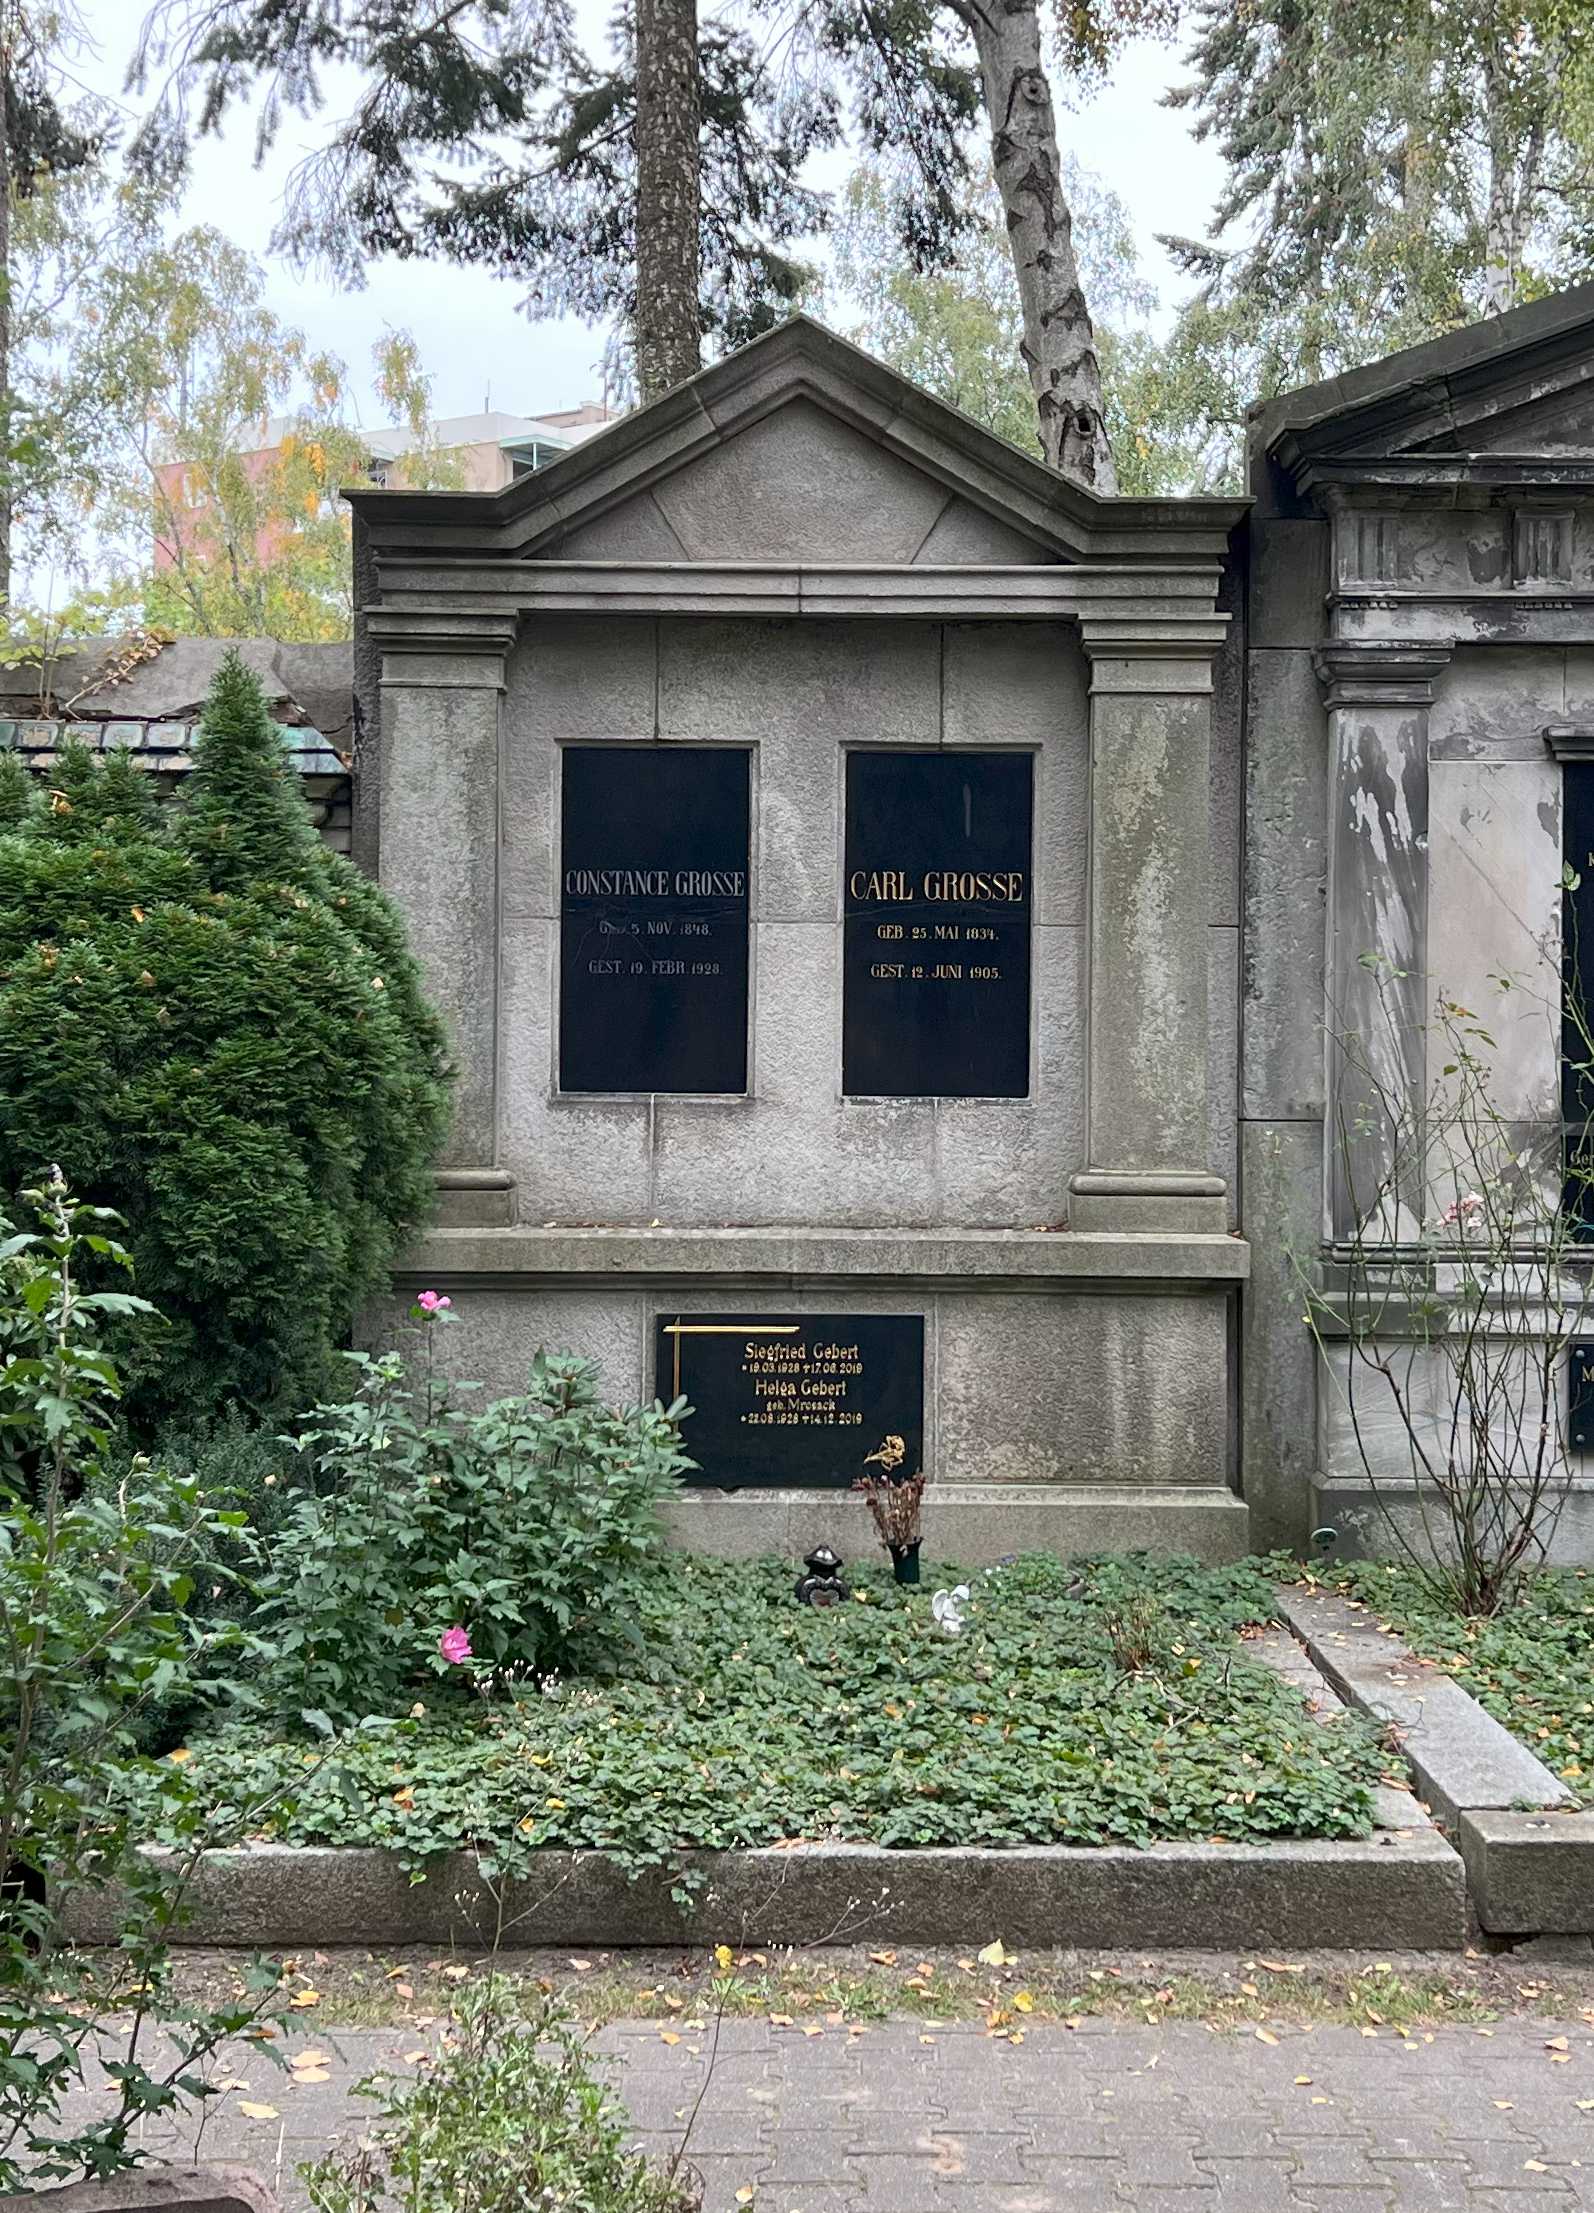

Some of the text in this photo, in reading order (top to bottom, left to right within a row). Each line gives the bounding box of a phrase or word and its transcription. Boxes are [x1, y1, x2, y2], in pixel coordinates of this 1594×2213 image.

[566, 870, 745, 897] CONSTANCE GROSSE
[850, 871, 1023, 902] CARL GROSSE
[934, 925, 960, 940] MAI
[870, 964, 908, 978] GEST.
[931, 964, 962, 979] JUNI
[744, 1342, 859, 1363] Siegfried Gebert
[755, 1378, 847, 1397] Helga Gebert
